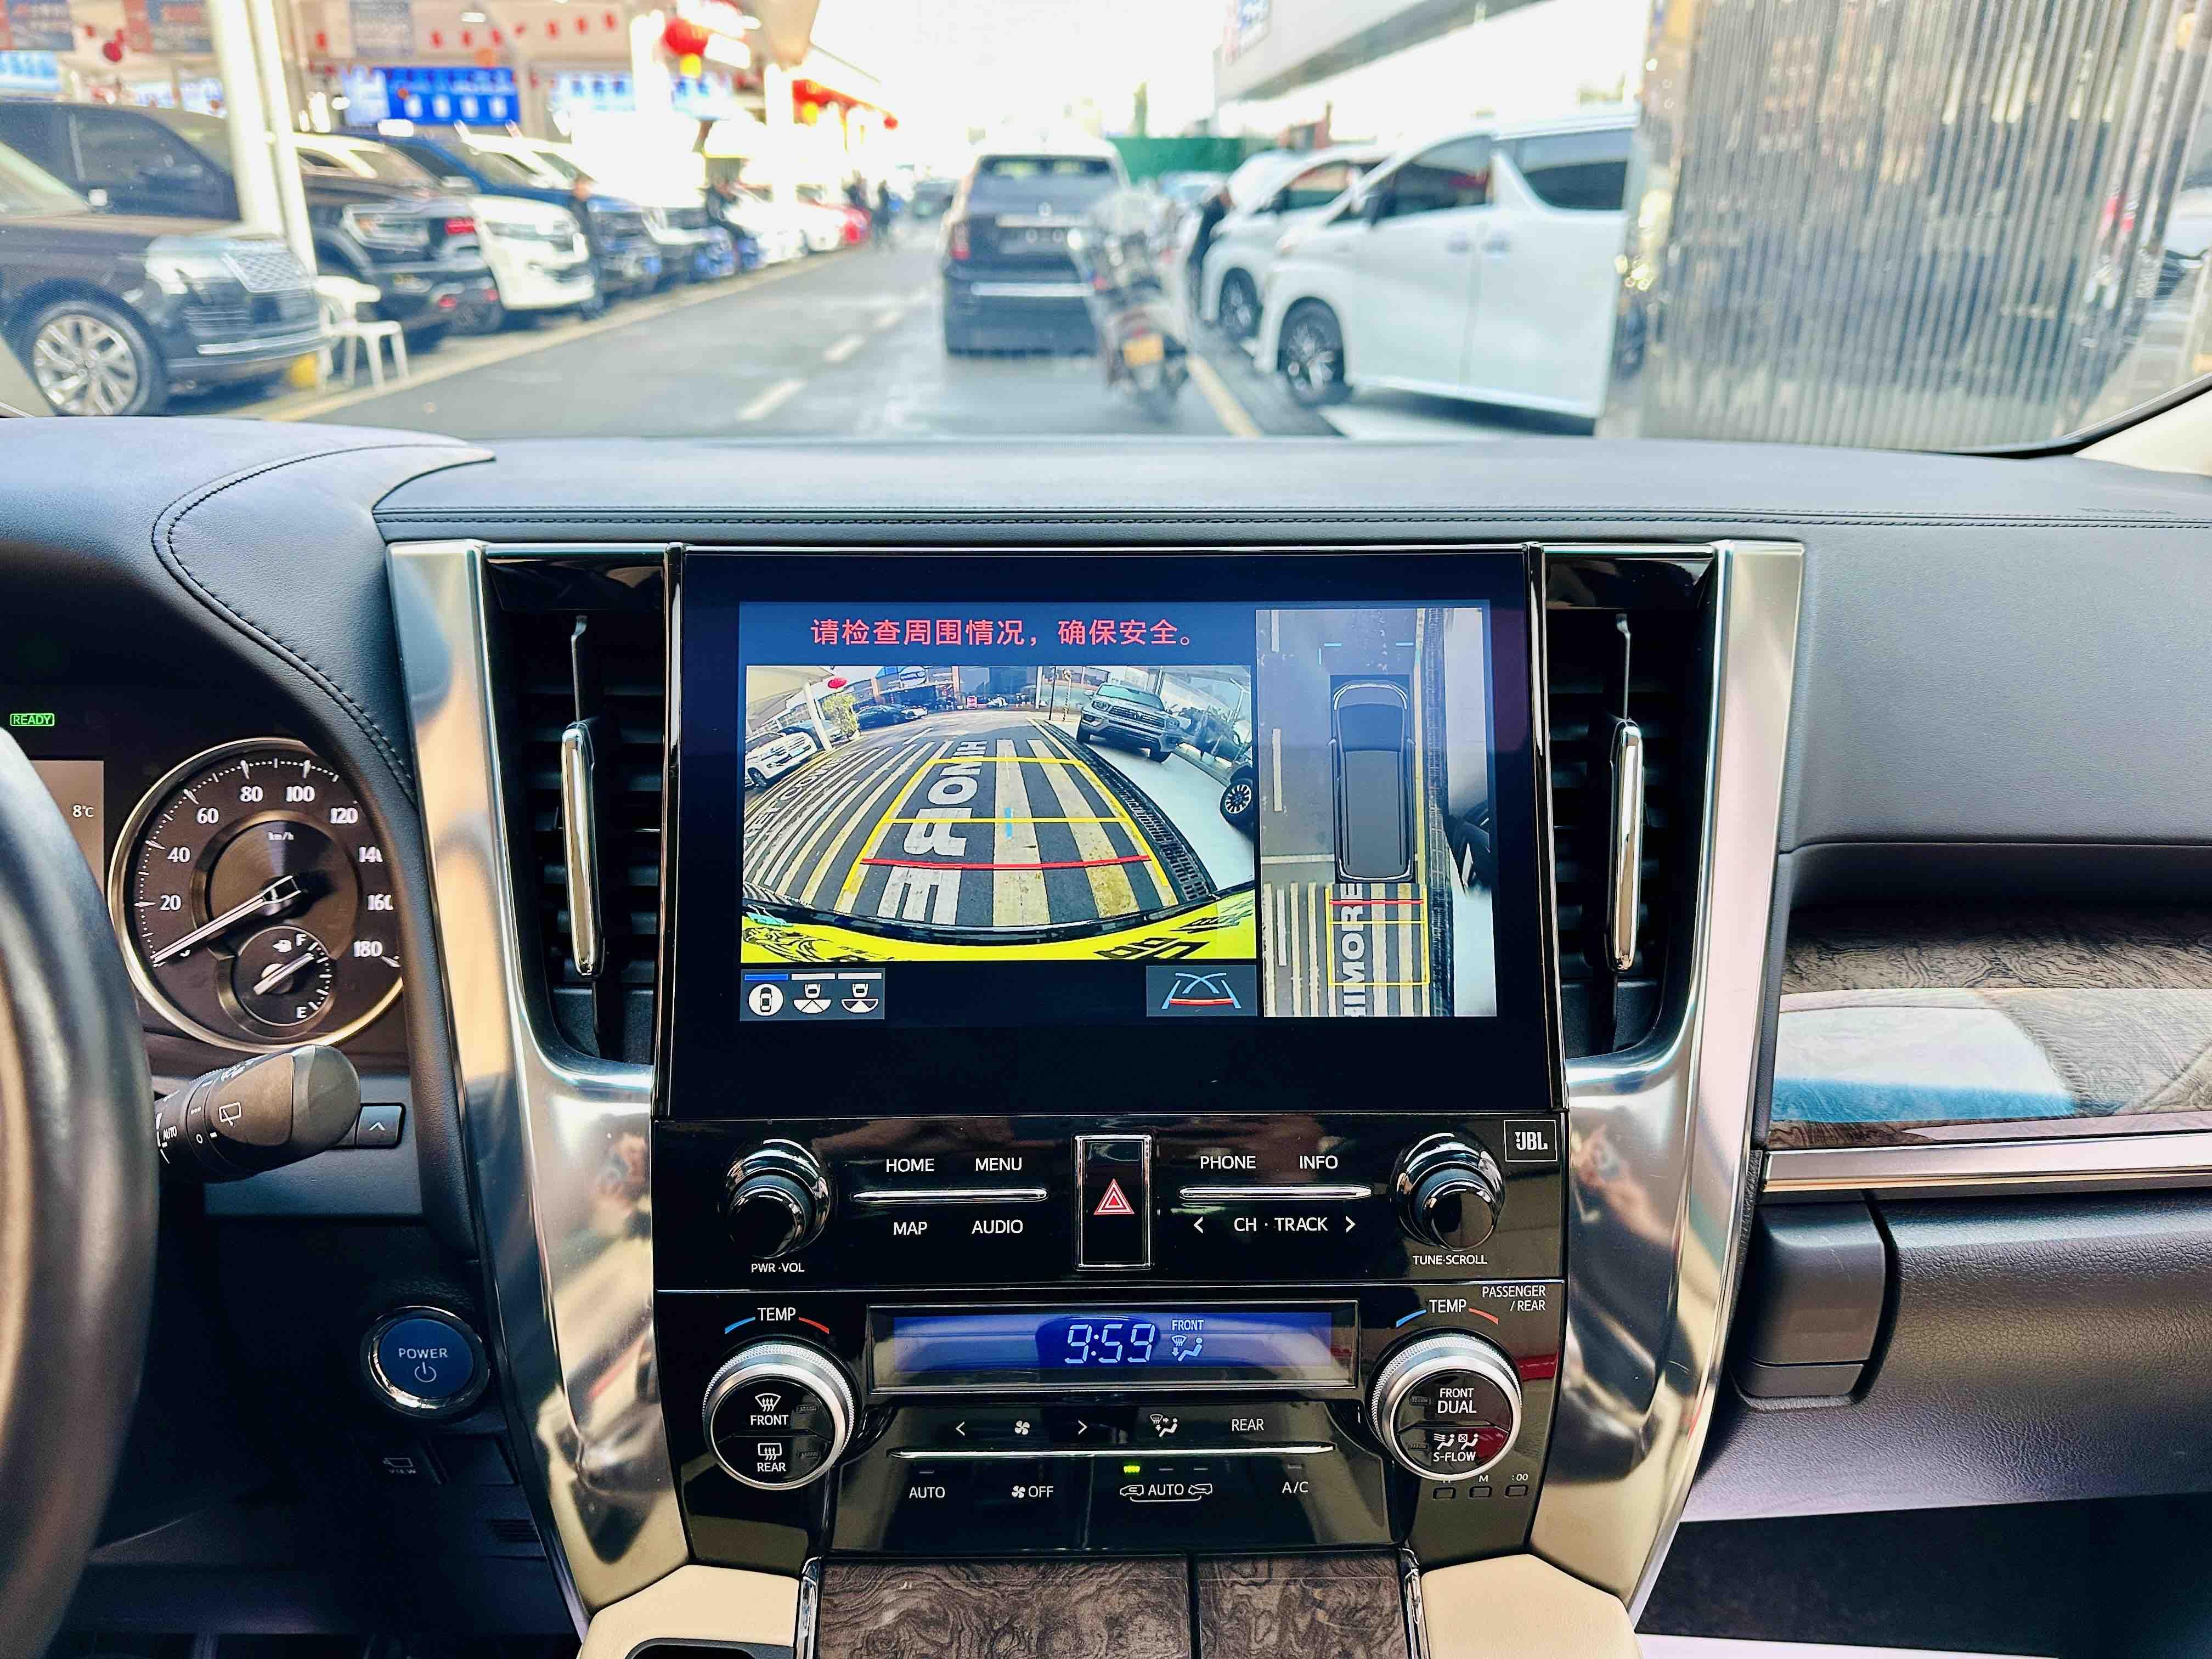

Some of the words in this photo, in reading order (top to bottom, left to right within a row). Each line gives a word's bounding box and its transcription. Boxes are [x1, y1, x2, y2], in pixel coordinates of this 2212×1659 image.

[812, 619, 1191, 646] 请检查周围情况，确保安全。
[13, 714, 51, 725] READY
[240, 786, 263, 802] 80
[286, 786, 315, 802] 100
[197, 808, 219, 824] 60
[330, 807, 358, 824] 120
[267, 832, 294, 840] km/h
[167, 847, 190, 863] 40
[159, 895, 182, 911] 20
[296, 934, 307, 946] F
[354, 940, 383, 957] 180
[296, 1006, 308, 1019] E
[162, 1126, 177, 1141] AUTO
[1514, 1131, 1548, 1150] JBL
[886, 1158, 935, 1172] HOME
[975, 1157, 1022, 1171] MENU
[1200, 1155, 1256, 1169] PHONE
[1300, 1155, 1338, 1169] INFO
[893, 1221, 928, 1235] MAP
[971, 1219, 1023, 1234] AUDIO
[1234, 1217, 1257, 1232] CH
[1274, 1217, 1328, 1232] TRACK
[1482, 1285, 1546, 1298] PASSENGER
[1429, 1299, 1467, 1313] TEMP
[757, 1307, 796, 1321] TEMP
[1172, 1319, 1204, 1330] FRONT
[1064, 1323, 1155, 1364] 9:59
[398, 1348, 448, 1359] POWER
[1440, 1387, 1474, 1398] FRONT
[1437, 1400, 1477, 1414] DUAL
[750, 1414, 789, 1425] FRONT
[1232, 1418, 1265, 1431] REAR
[1433, 1451, 1476, 1462] S-FLOW
[757, 1462, 786, 1472] REAR
[909, 1486, 945, 1498] AUTO
[1028, 1486, 1054, 1498] OFF
[1148, 1483, 1184, 1496] AUTO
[1282, 1481, 1308, 1493] A/C
